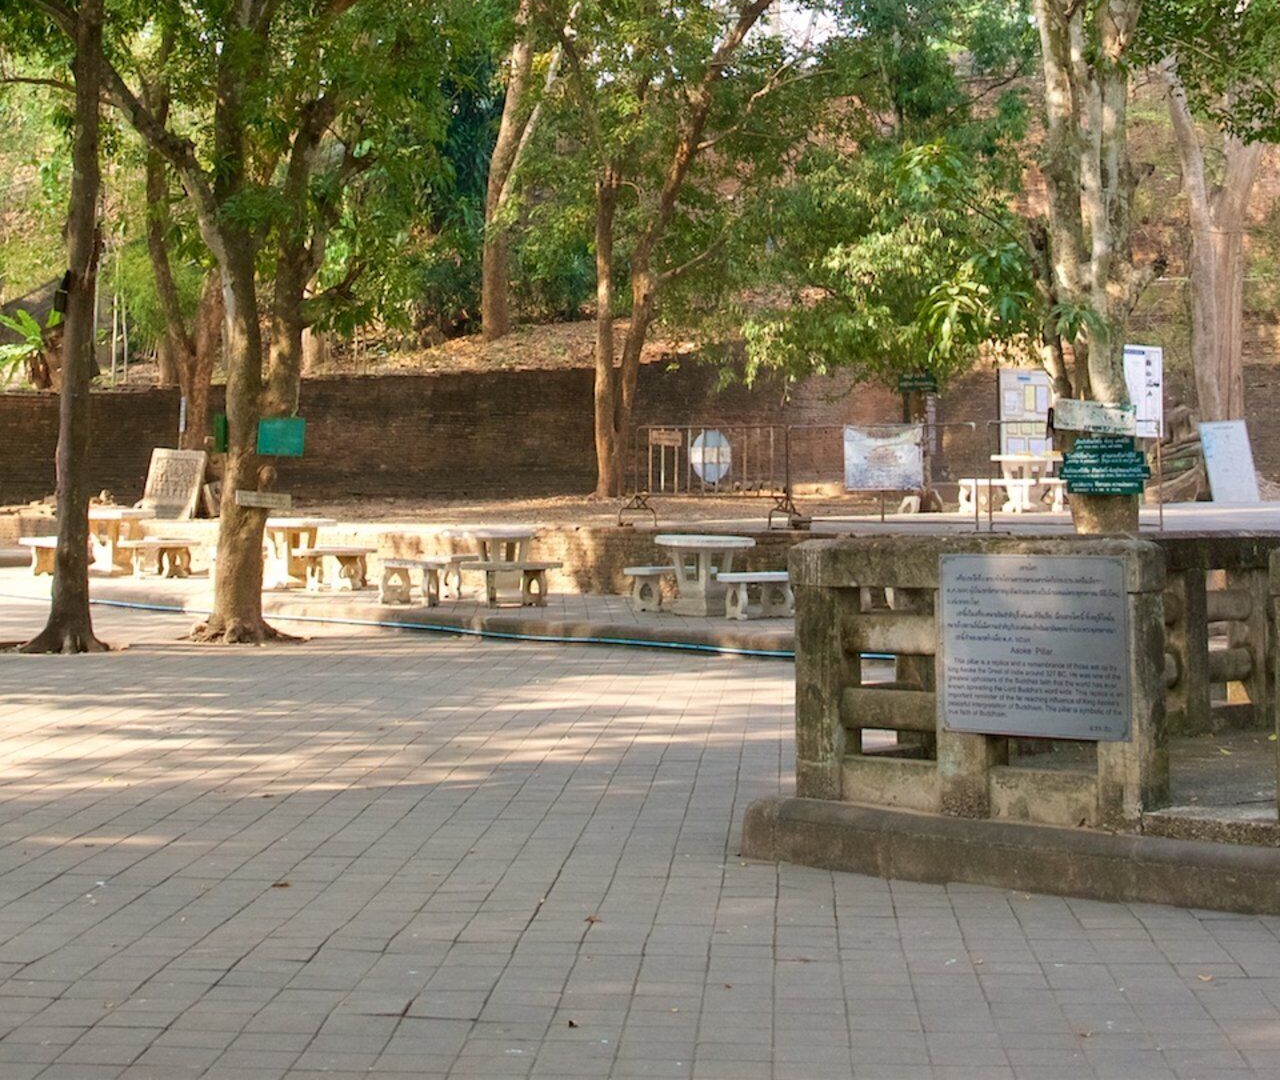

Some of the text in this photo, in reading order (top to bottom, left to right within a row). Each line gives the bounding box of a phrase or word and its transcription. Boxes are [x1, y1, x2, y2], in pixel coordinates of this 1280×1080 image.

[1010, 646, 1053, 655] Asoke Pillar
[1058, 705, 1071, 713] pillar
[1079, 707, 1104, 715] symbolic
